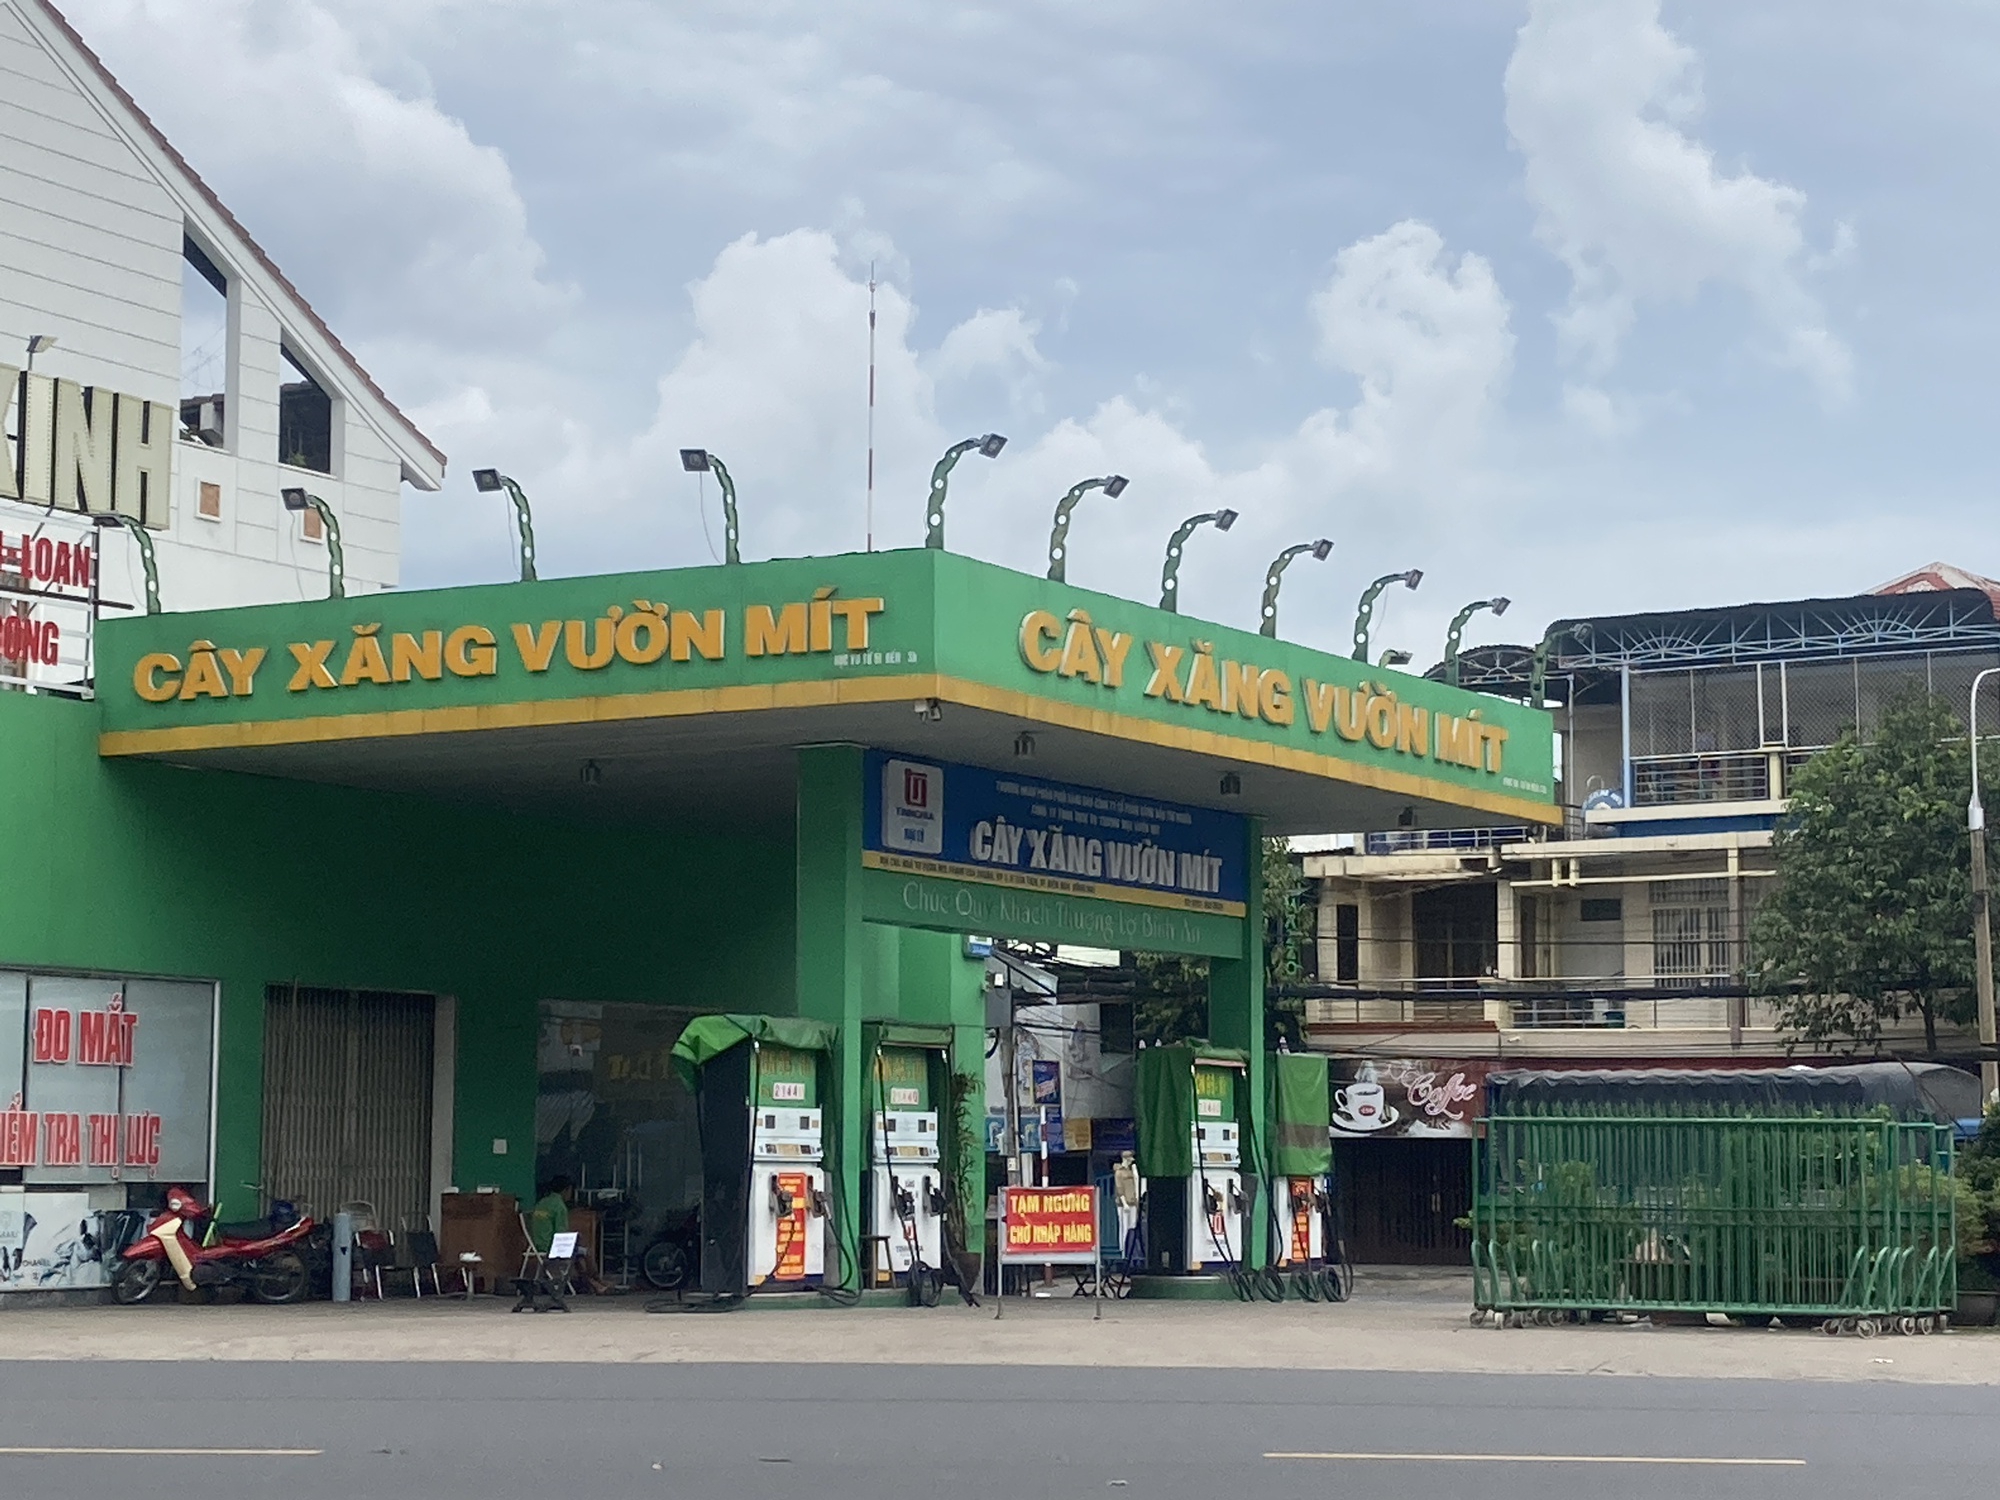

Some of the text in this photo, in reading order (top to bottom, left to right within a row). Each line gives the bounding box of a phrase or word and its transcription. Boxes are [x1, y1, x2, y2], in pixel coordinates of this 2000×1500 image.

[20, 534, 90, 592] LOẠN
[133, 586, 885, 702] CÂY XĂNG VƯỜN MÍT
[1019, 608, 1509, 773] CÂY XĂNG VƯỜN MÍT
[970, 815, 1023, 865] CÂY
[1026, 824, 1103, 878] XĂNG
[1105, 838, 1176, 887] VƯỜN
[1178, 849, 1222, 893] MÍT
[33, 992, 138, 1066] ĐO MẮT
[43, 1111, 82, 1165] TRA
[88, 1112, 120, 1179] THỊ
[124, 1110, 162, 1179] LỰC
[1010, 1195, 1040, 1218] TẠM
[1062, 1221, 1092, 1243] HÀNG
